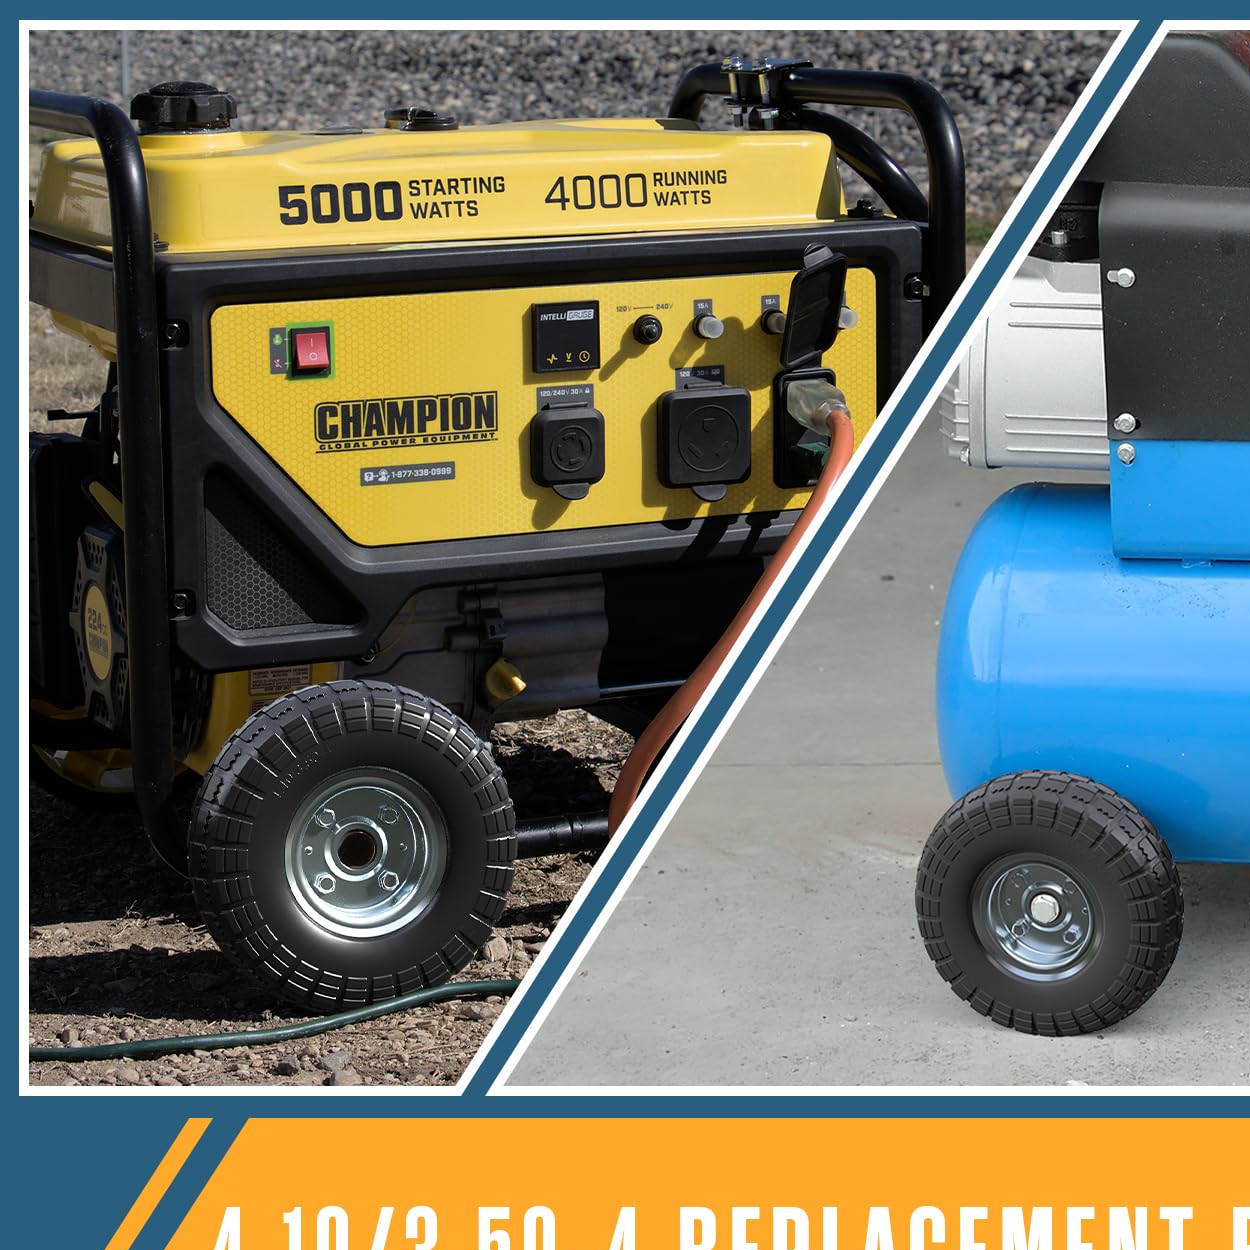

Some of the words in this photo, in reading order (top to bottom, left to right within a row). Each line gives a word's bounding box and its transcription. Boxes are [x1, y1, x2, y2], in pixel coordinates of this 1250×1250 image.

[278, 180, 404, 226] 5000
[408, 176, 506, 197] STARTING
[544, 173, 648, 211] 4000
[653, 169, 727, 187] RUNNING
[653, 190, 712, 206] WATTS
[409, 200, 480, 219] WATTS
[315, 392, 496, 442] CHAMPION
[319, 441, 368, 451] GLOBAL
[372, 437, 417, 447] POWER
[422, 432, 496, 444] EQUIPMENT
